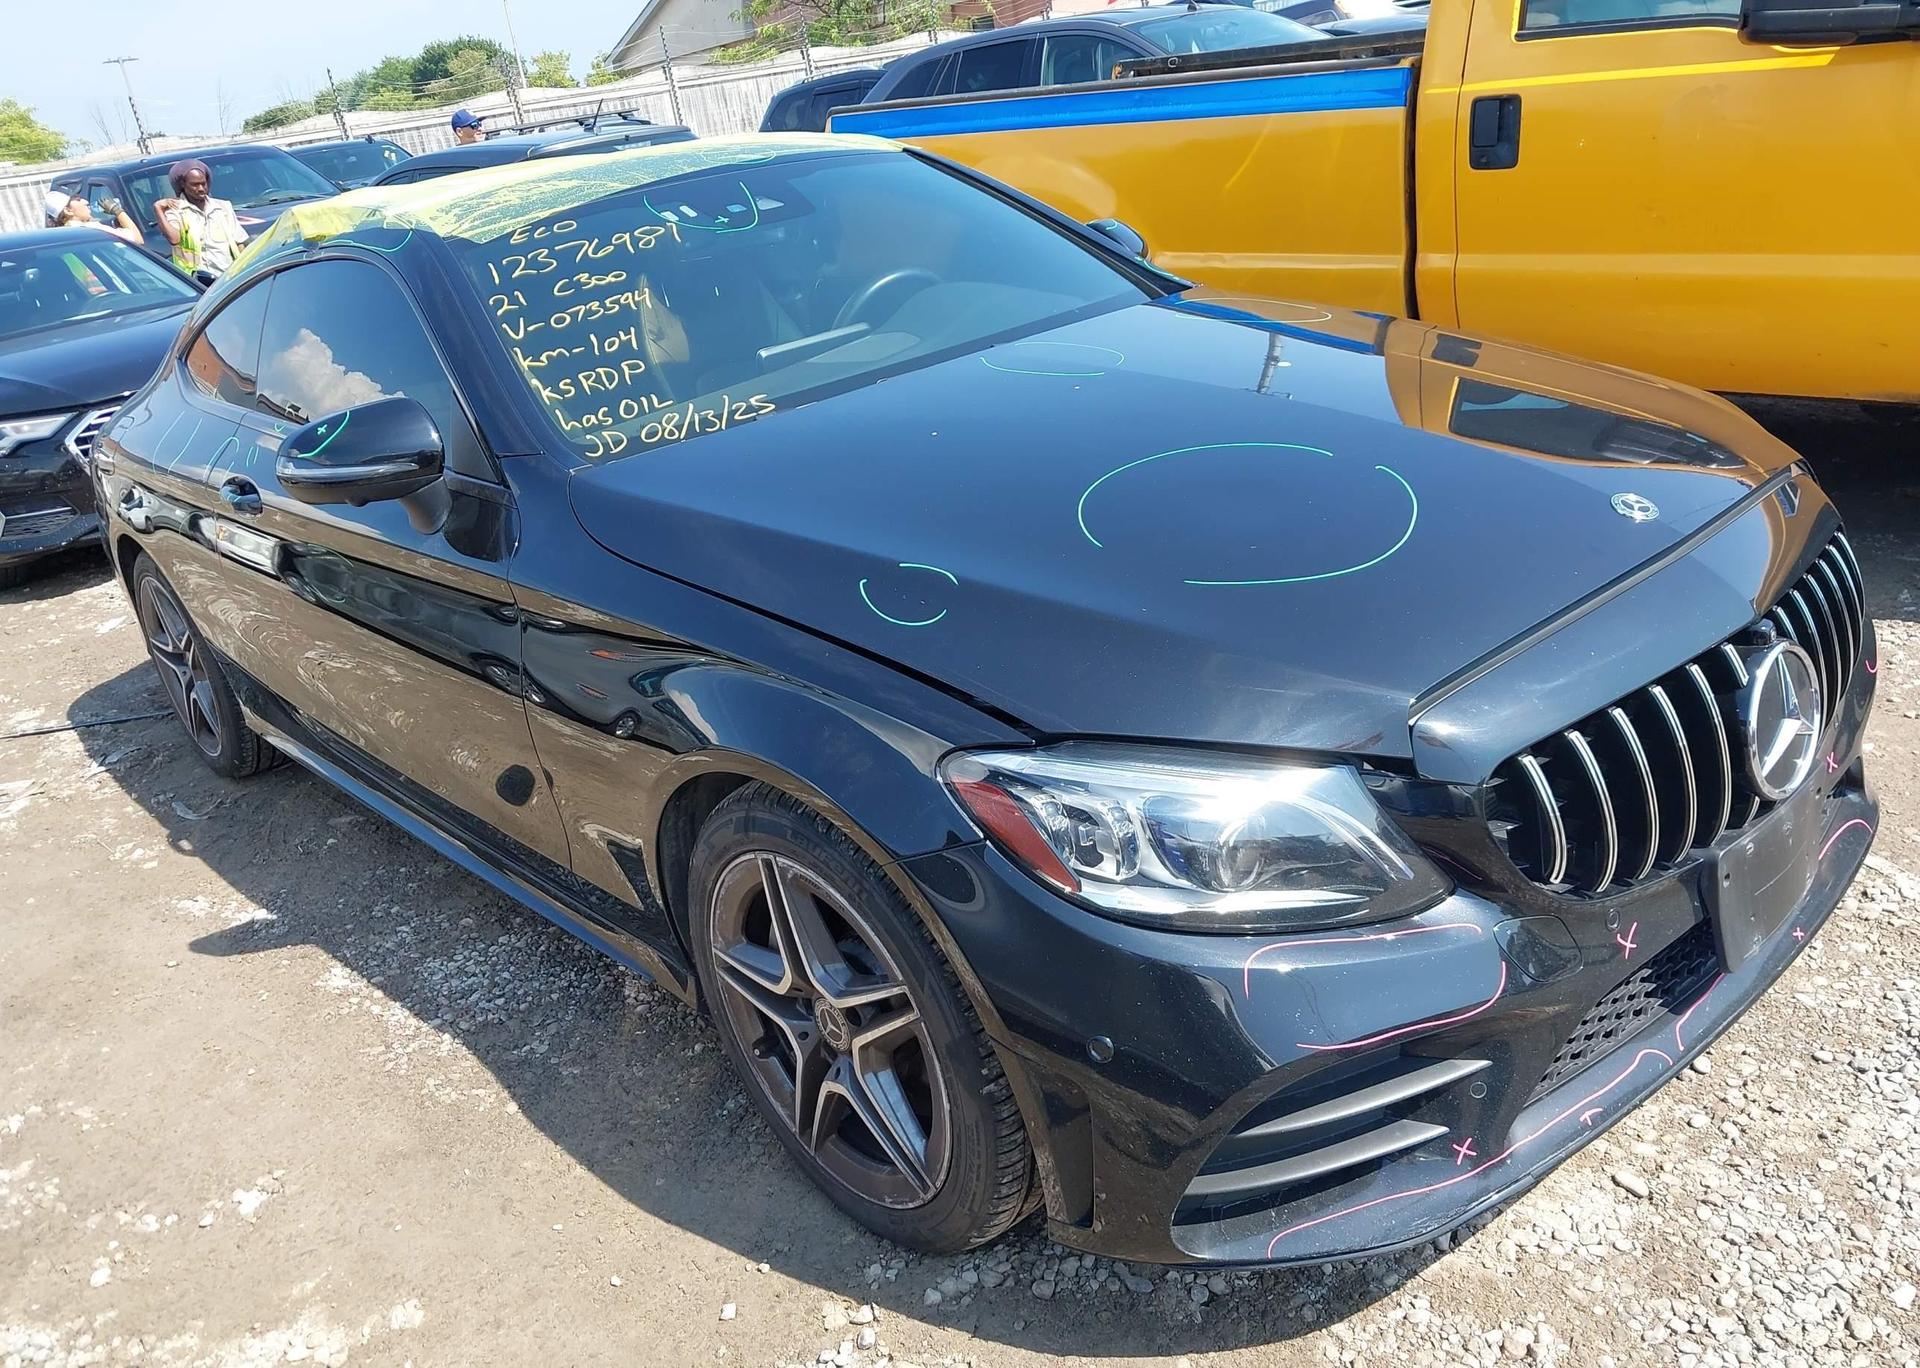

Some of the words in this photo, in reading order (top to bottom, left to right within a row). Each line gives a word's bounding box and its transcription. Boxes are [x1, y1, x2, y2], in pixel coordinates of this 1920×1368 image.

[510, 220, 577, 244] ECO
[489, 290, 527, 316] 21
[553, 271, 627, 296] C300
[502, 287, 653, 341] V-073594
[584, 430, 628, 457] JD
[640, 394, 776, 443] 08/13/25
